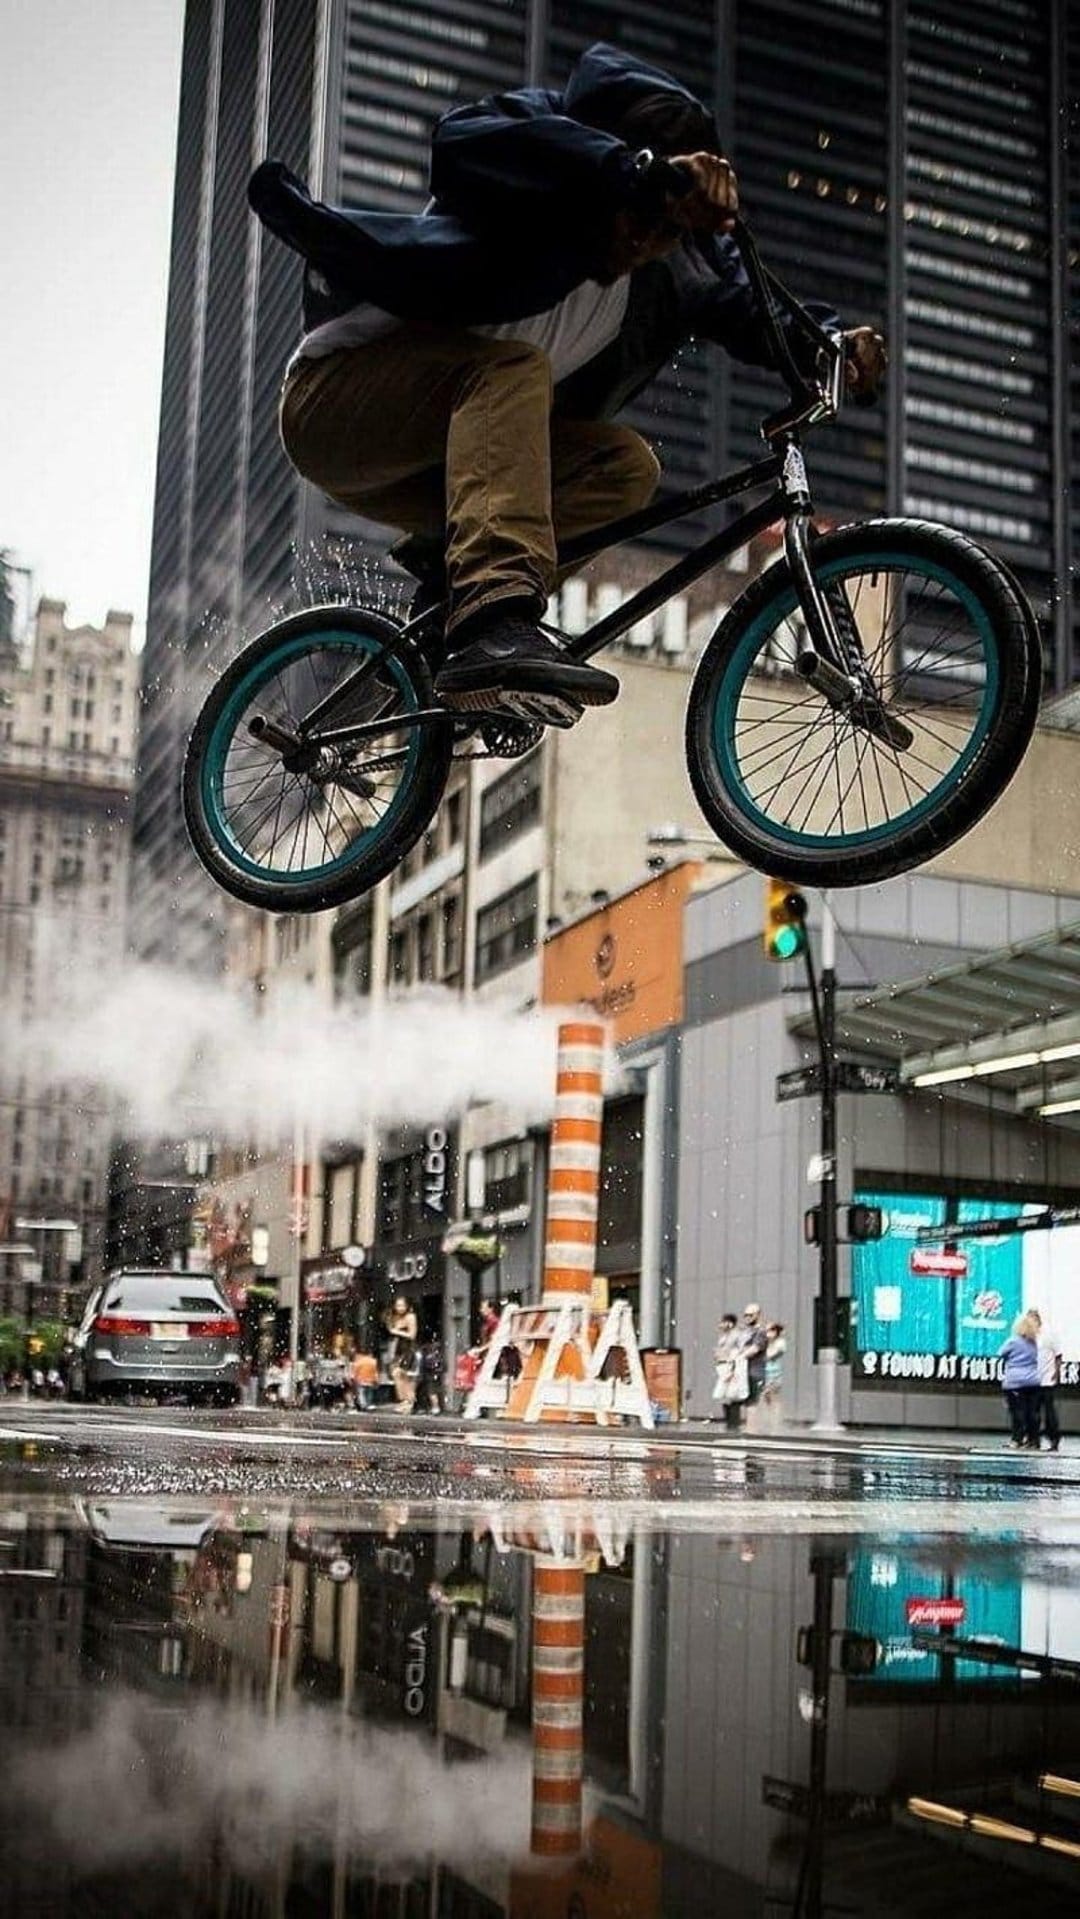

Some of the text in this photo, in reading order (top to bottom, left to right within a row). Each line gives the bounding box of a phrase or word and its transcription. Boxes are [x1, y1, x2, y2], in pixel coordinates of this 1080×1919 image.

[425, 1128, 447, 1212] ALDO
[881, 1353, 935, 1379] FOUND
[937, 1355, 958, 1379] AT
